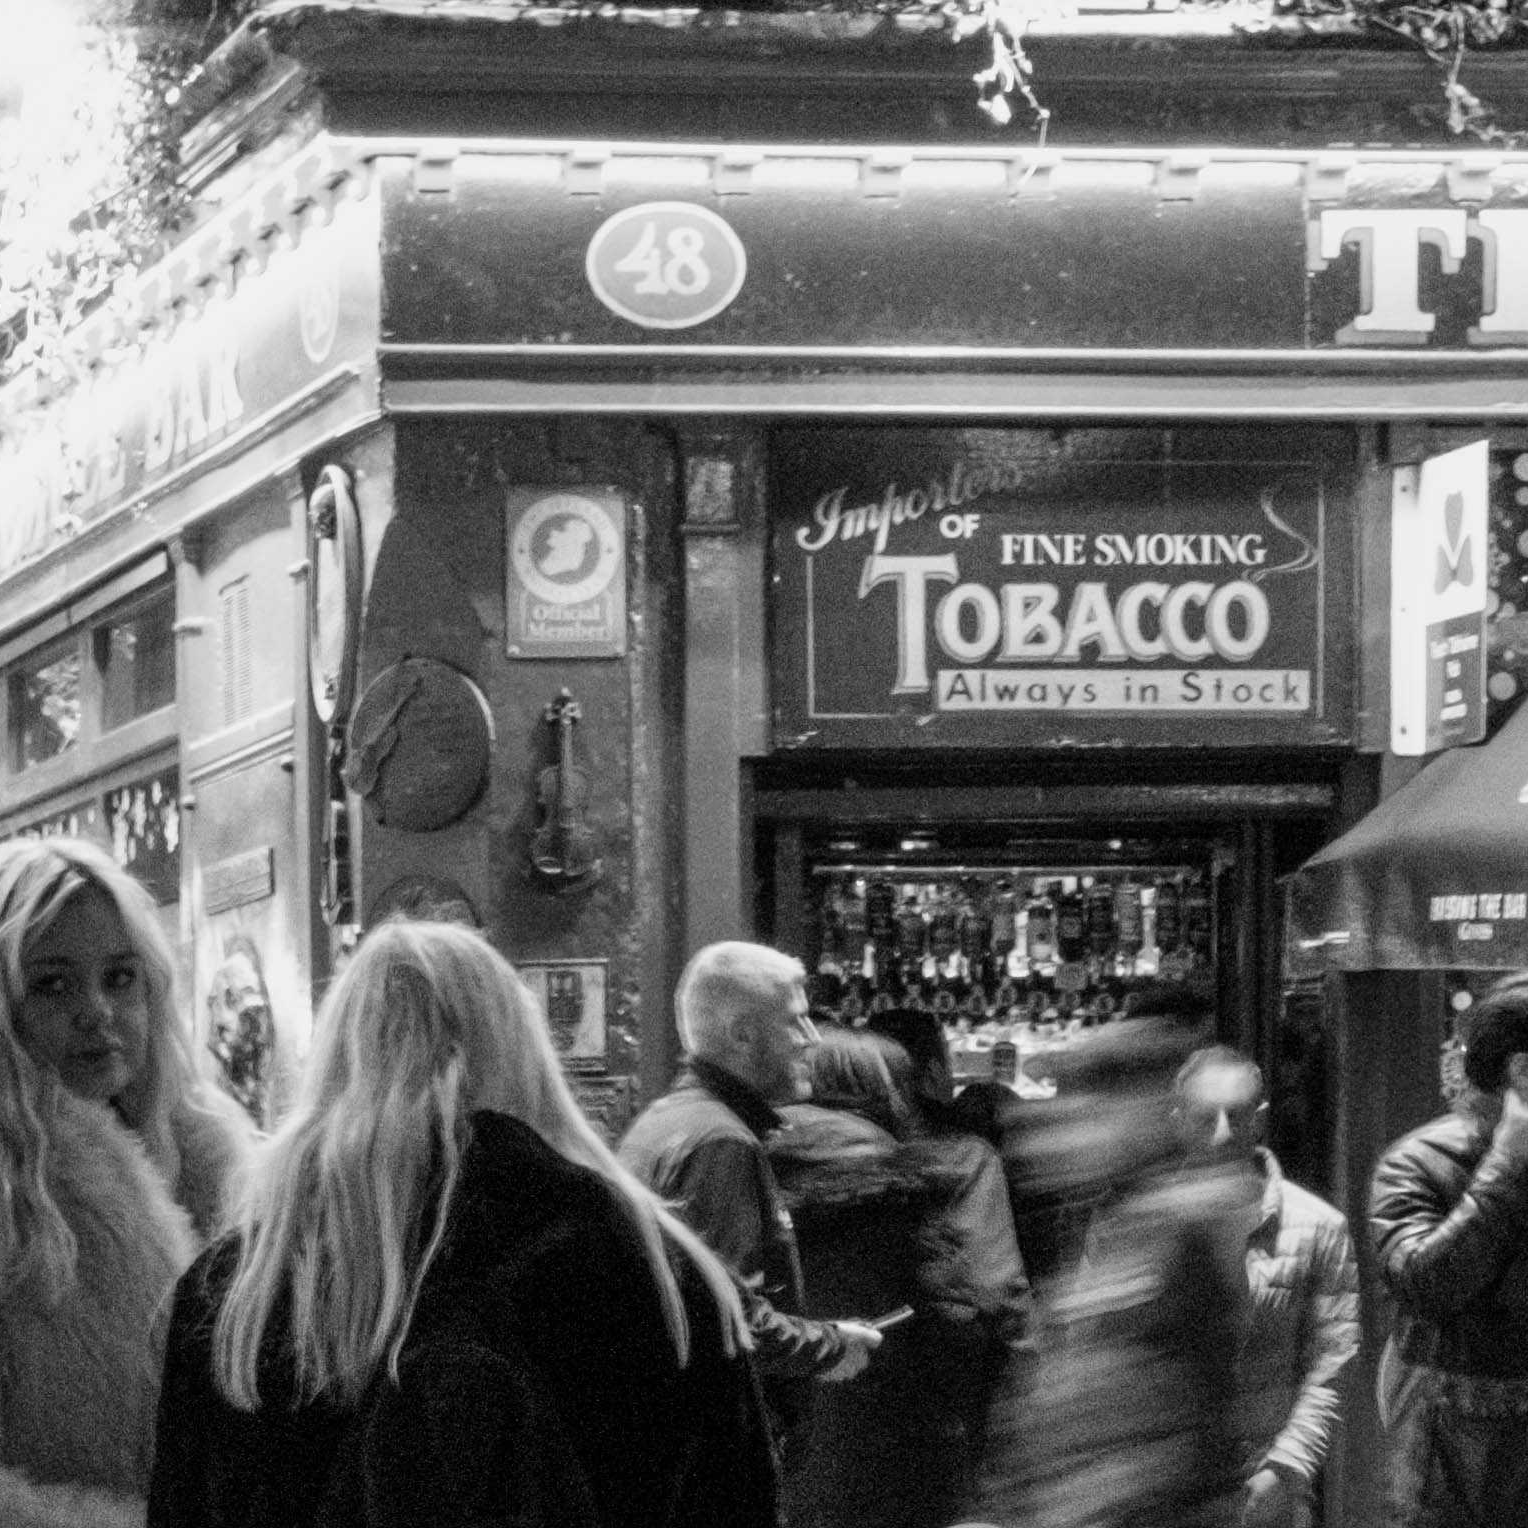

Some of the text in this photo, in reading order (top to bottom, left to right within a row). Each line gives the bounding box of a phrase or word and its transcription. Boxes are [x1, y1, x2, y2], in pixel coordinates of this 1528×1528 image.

[614, 220, 711, 295] 48
[939, 513, 981, 539] OF
[1001, 533, 1268, 566] FINE SMOKING
[858, 553, 1270, 694] TOBACCO
[946, 671, 1302, 707] Always in Stock
